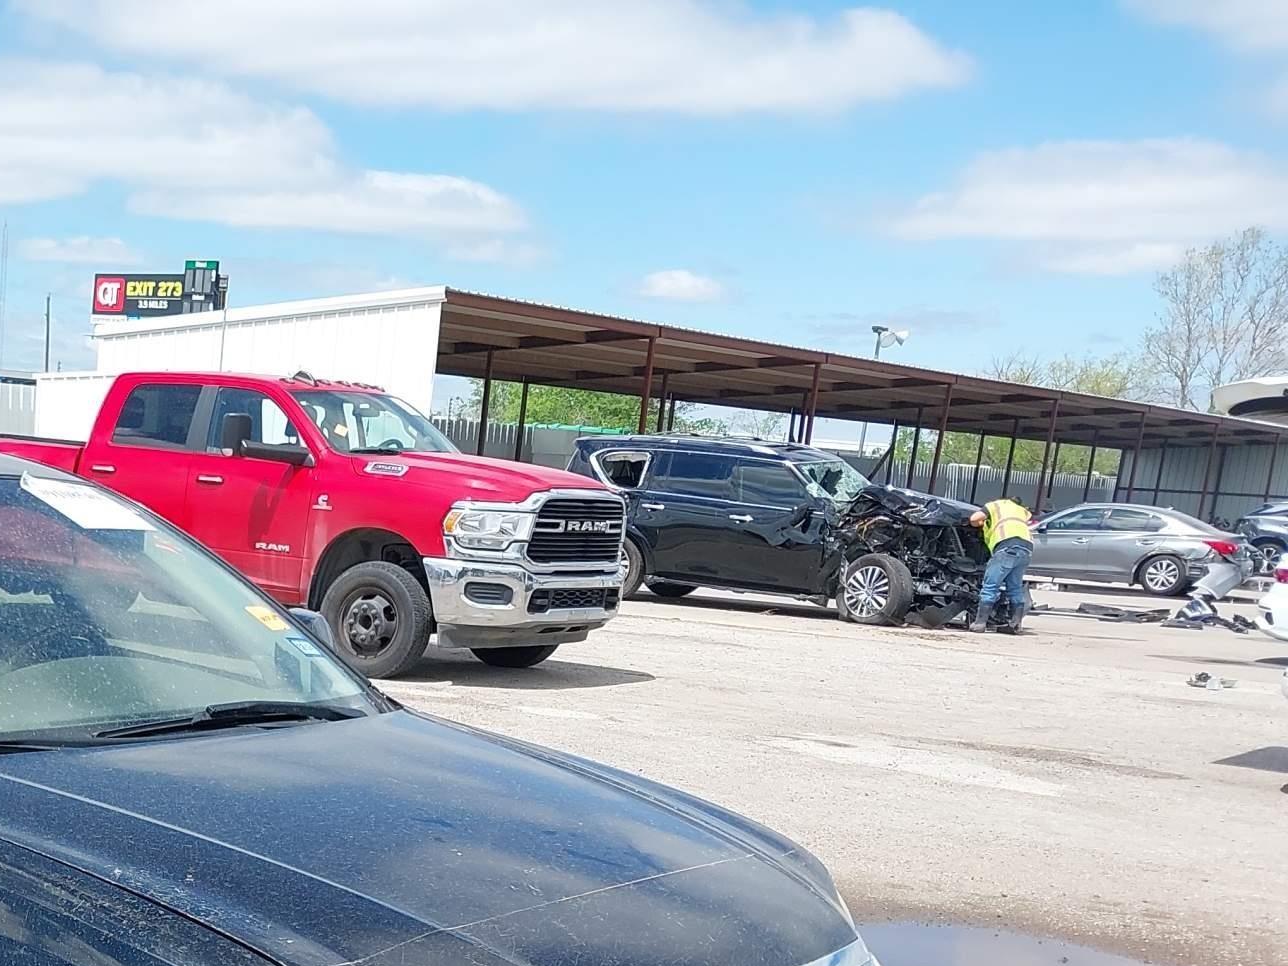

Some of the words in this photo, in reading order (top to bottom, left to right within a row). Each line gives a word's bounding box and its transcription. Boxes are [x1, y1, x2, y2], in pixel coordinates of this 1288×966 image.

[98, 282, 120, 307] QT
[126, 281, 156, 296] EXIT
[157, 281, 183, 297] 273
[567, 520, 607, 532] RAM
[255, 542, 290, 553] RAM
